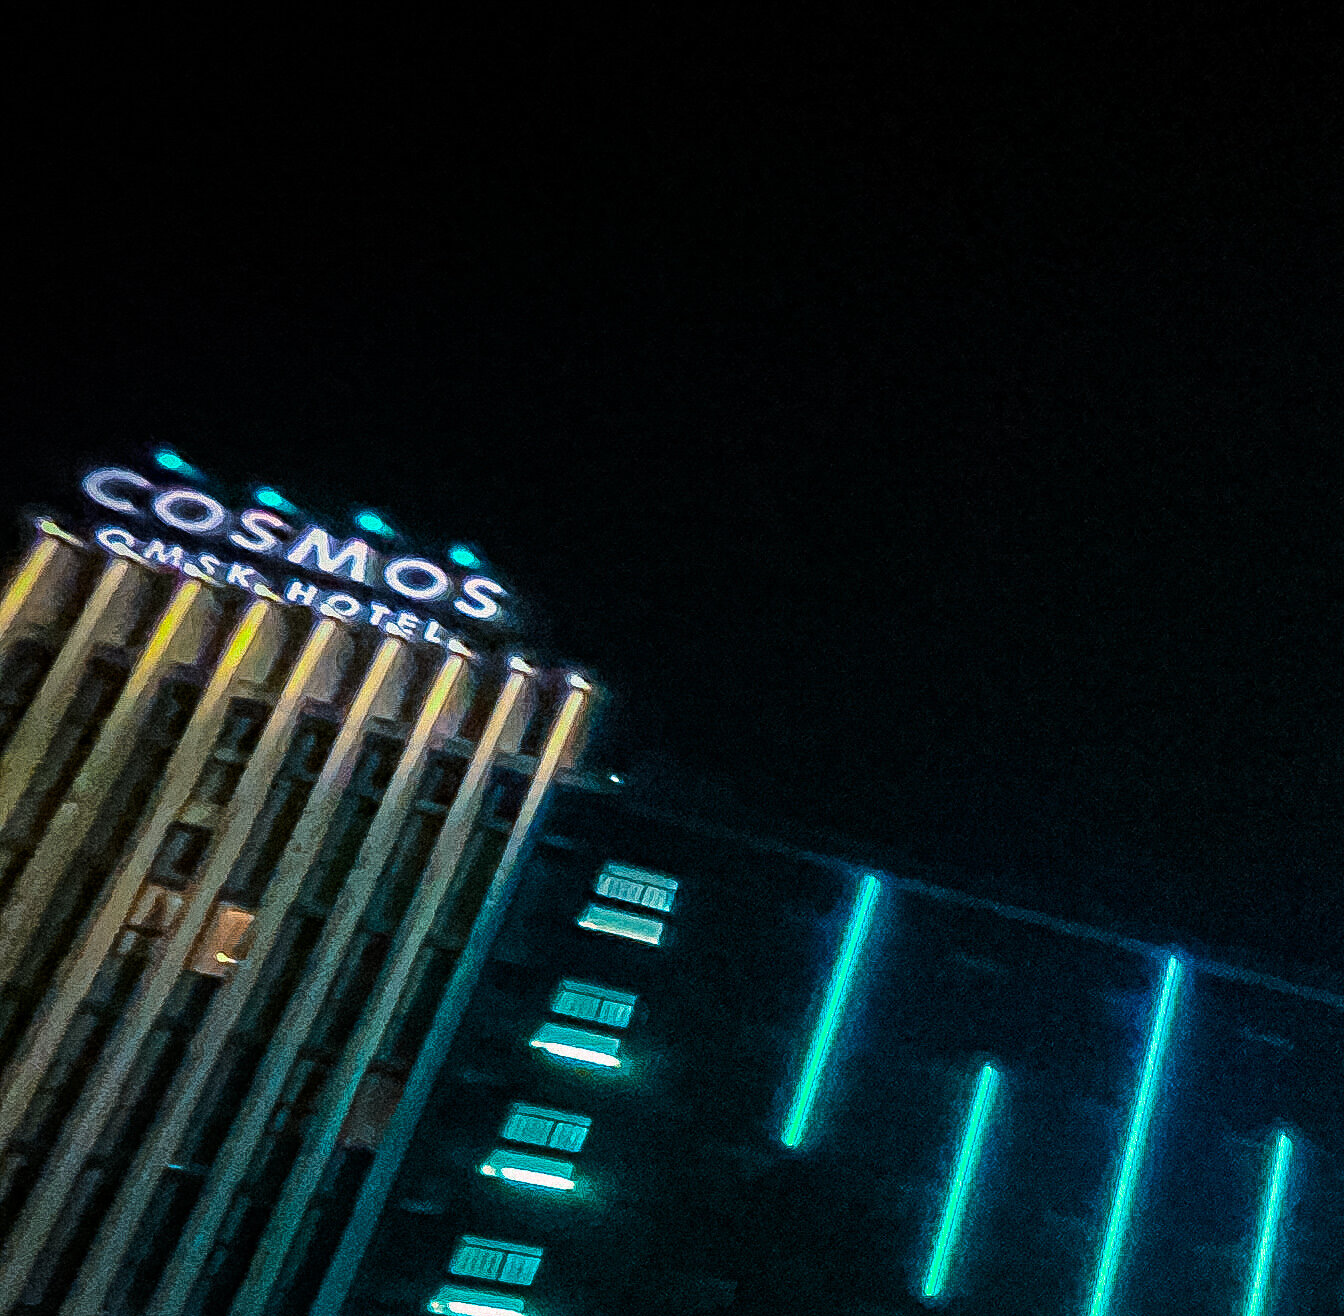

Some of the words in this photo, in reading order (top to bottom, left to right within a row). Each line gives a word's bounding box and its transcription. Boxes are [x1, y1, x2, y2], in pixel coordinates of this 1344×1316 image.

[82, 467, 508, 621] COSMOS
[96, 526, 256, 588] OMSK
[286, 580, 458, 649] HOTEL
